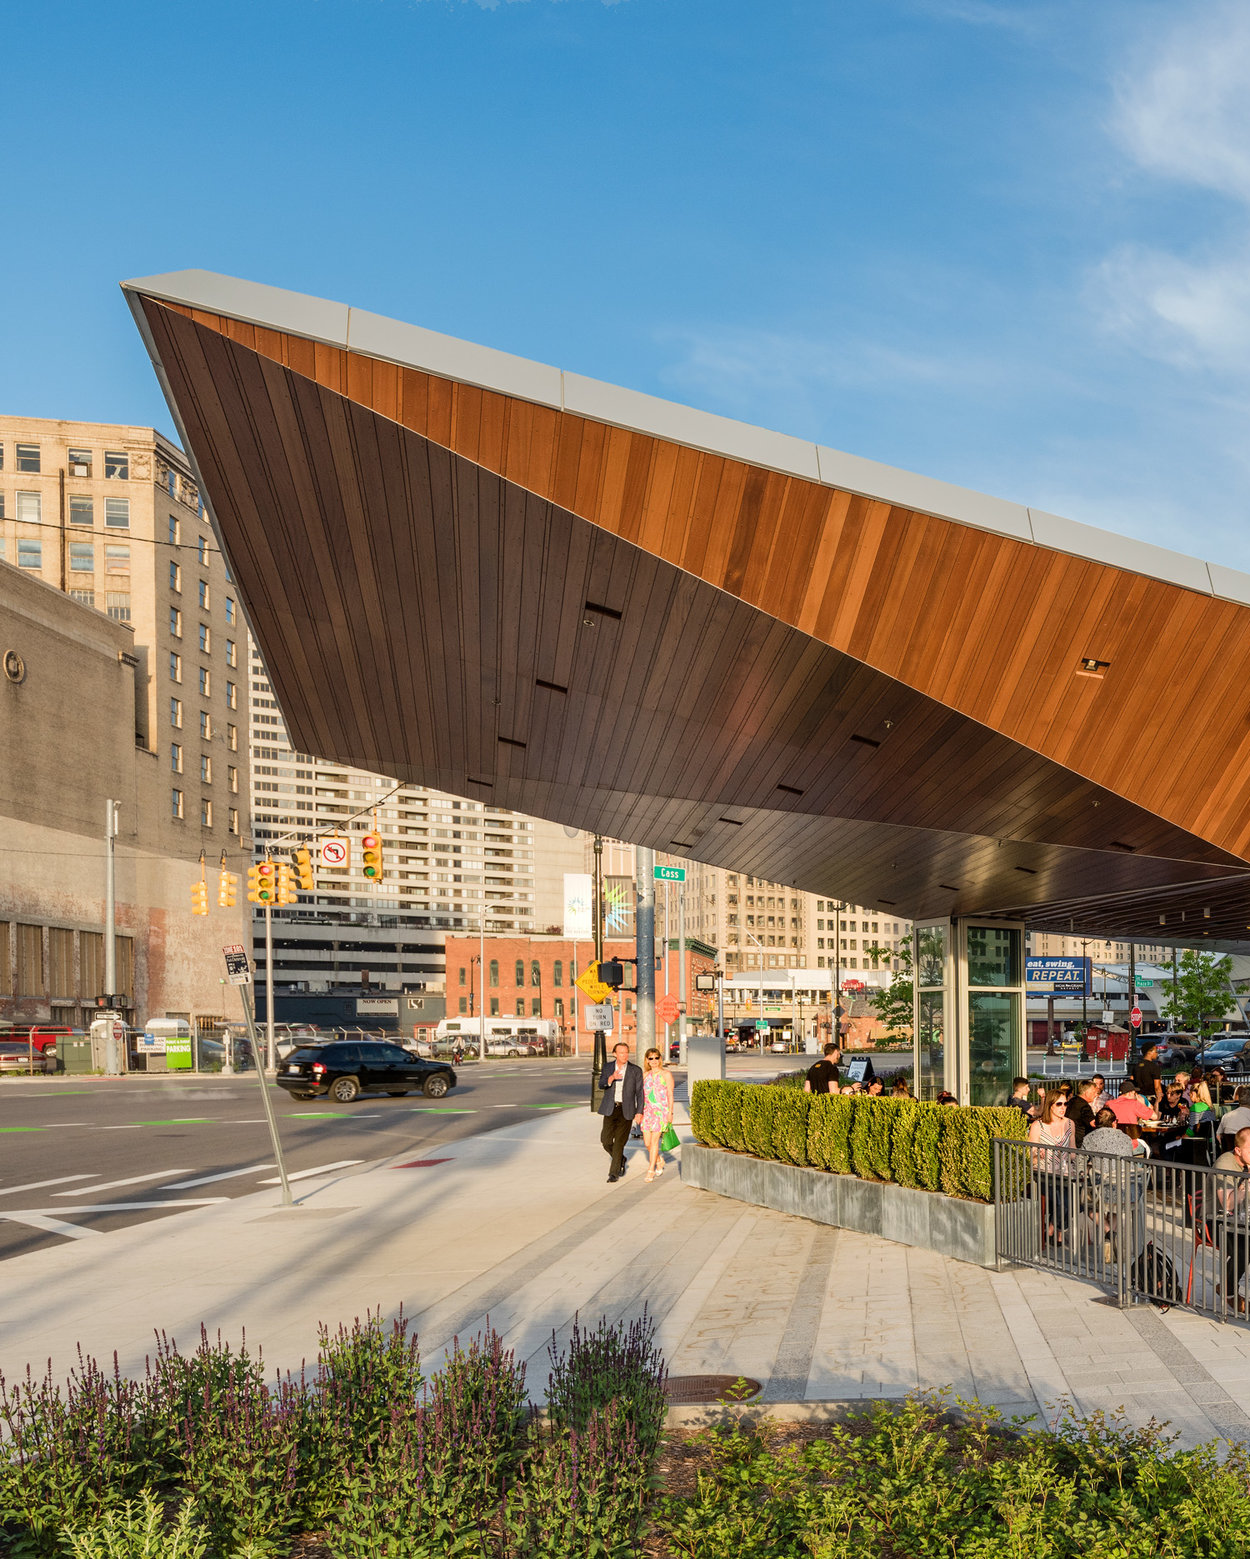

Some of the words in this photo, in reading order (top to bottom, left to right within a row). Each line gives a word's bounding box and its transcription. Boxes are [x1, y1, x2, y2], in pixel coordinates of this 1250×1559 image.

[661, 868, 679, 878] Cass
[1027, 960, 1044, 968] eat,
[1032, 971, 1080, 981] REPEAT.
